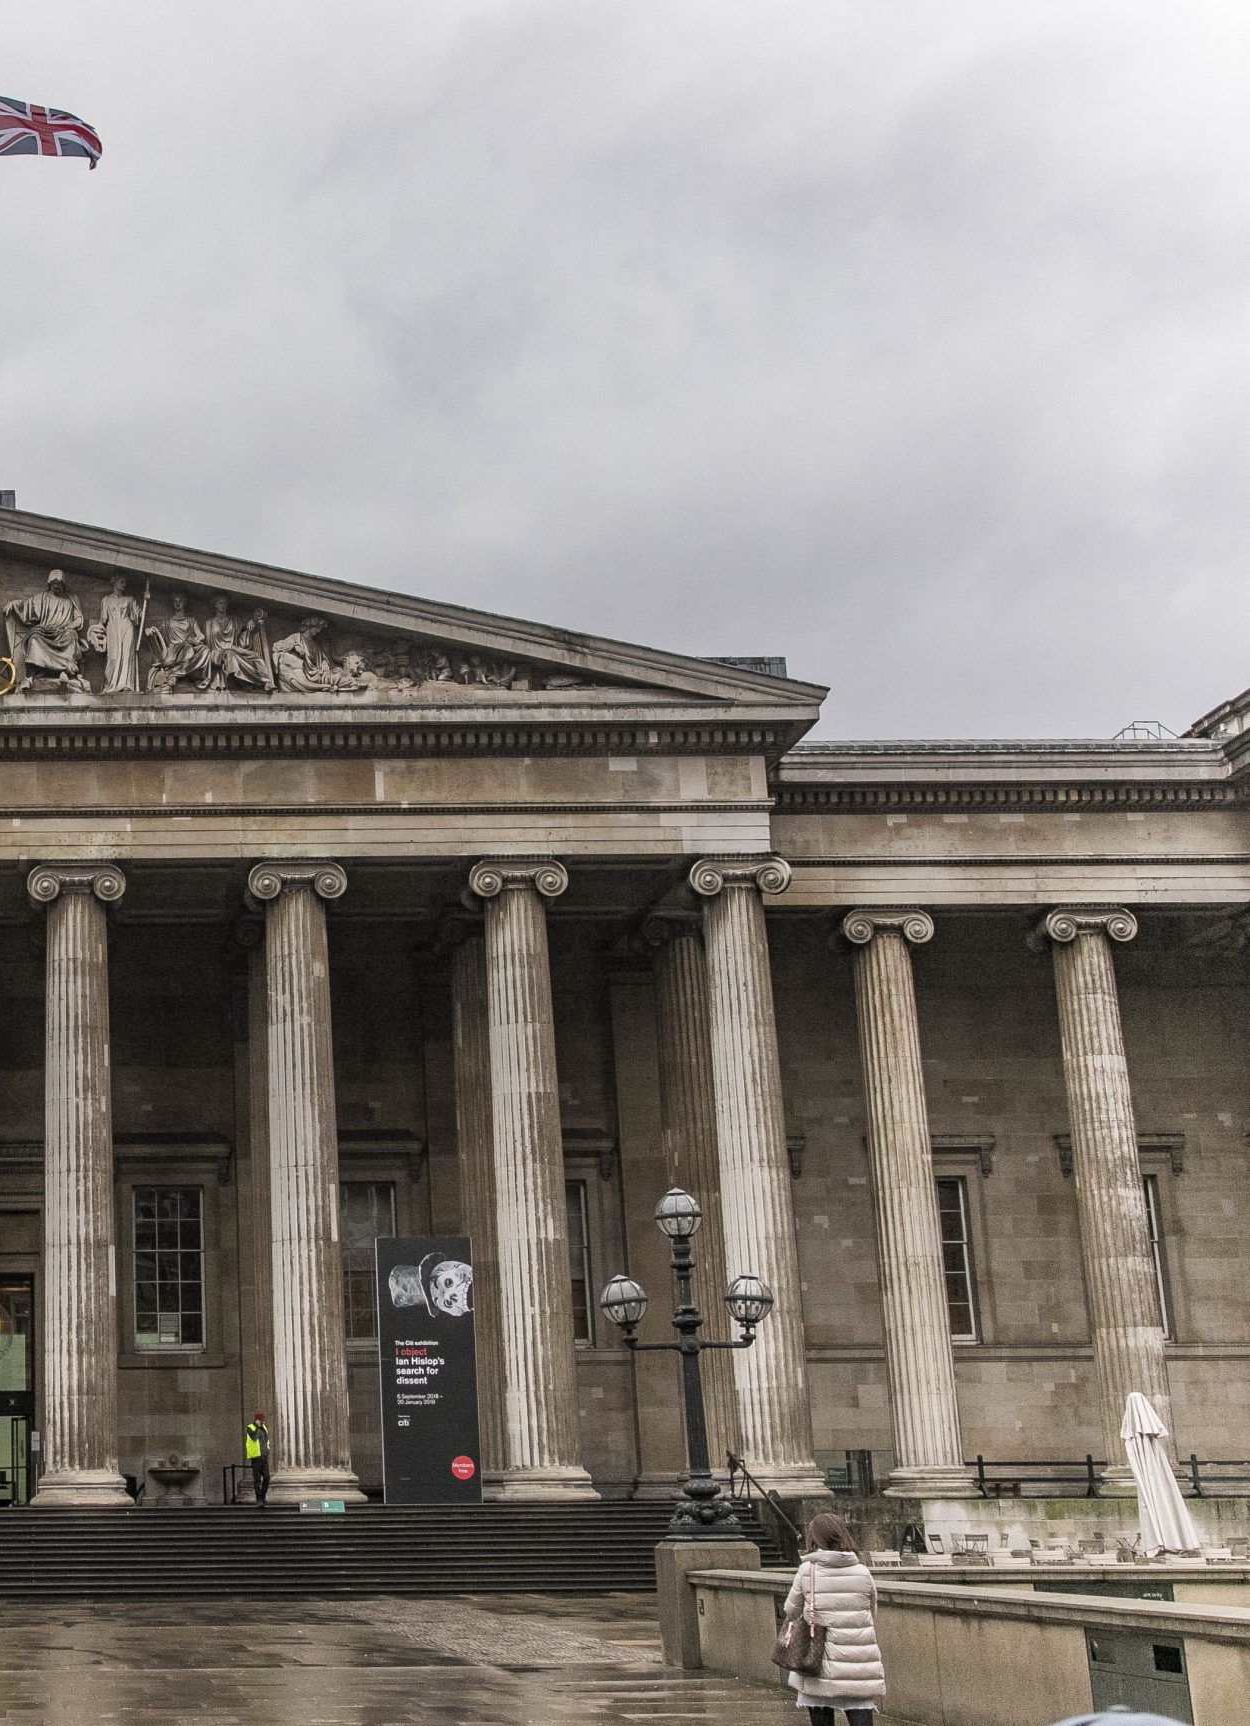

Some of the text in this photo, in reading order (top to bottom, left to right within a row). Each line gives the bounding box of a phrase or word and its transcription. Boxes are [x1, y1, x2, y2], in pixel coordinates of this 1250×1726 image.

[401, 1348, 427, 1357] object
[396, 1356, 444, 1366] Ian Hislop's
[396, 1366, 438, 1375] search for
[396, 1376, 428, 1384] dissent
